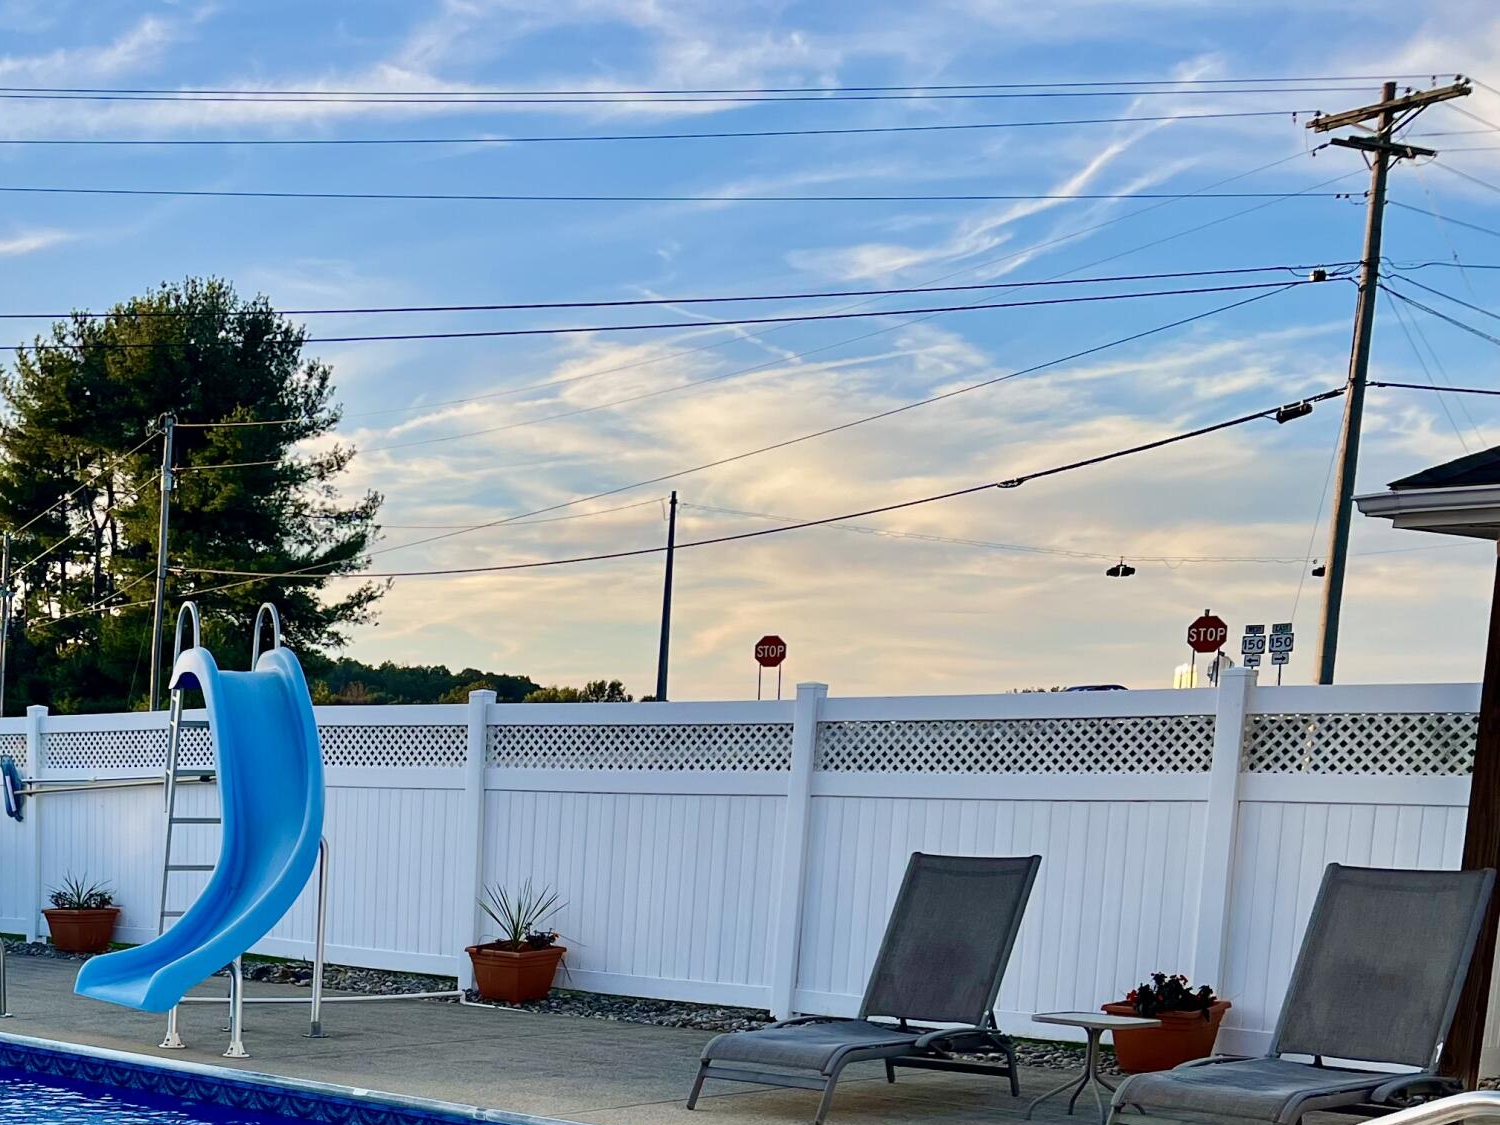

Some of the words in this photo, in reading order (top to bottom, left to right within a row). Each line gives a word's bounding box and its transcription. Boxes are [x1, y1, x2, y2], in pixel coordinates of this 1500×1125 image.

[1189, 628, 1226, 642] STOP
[1243, 639, 1264, 650] 150
[1271, 636, 1292, 648] 150
[757, 645, 785, 657] STOP
